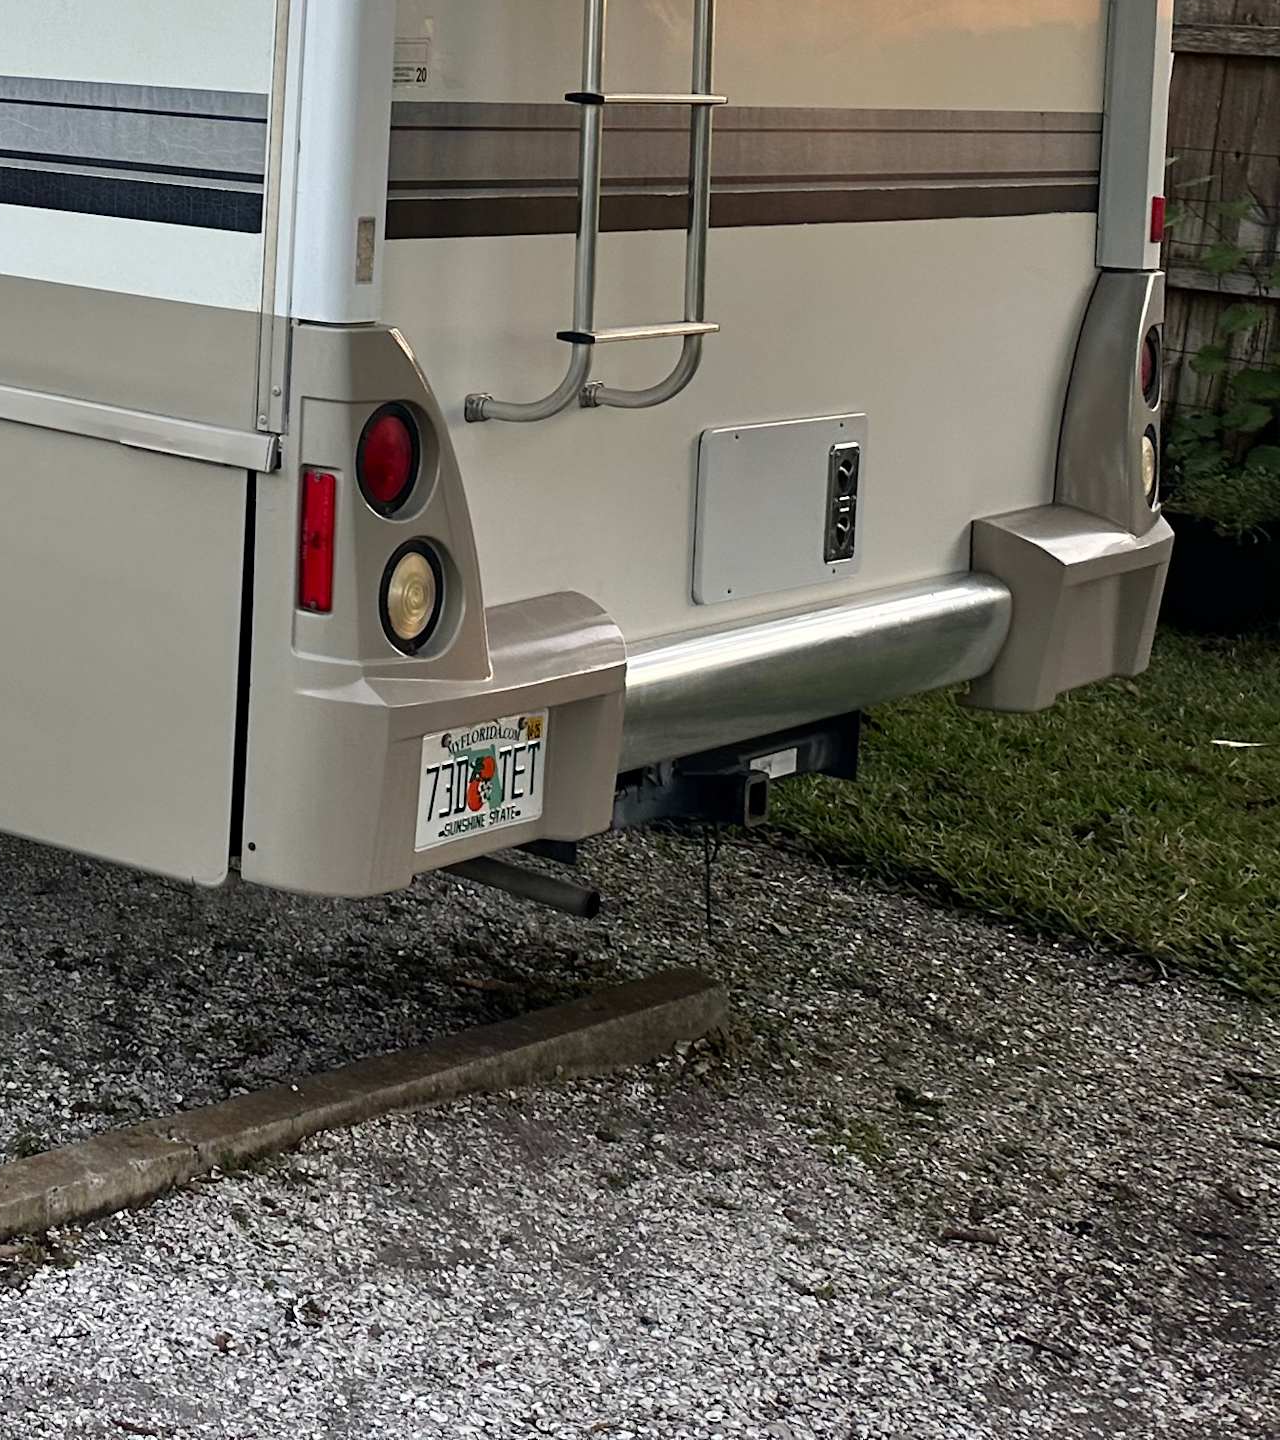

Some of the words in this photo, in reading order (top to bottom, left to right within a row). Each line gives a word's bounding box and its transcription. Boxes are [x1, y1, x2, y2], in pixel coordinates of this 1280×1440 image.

[499, 740, 541, 802] TET
[444, 812, 487, 837] SUNSHINE
[489, 805, 516, 825] STATE
